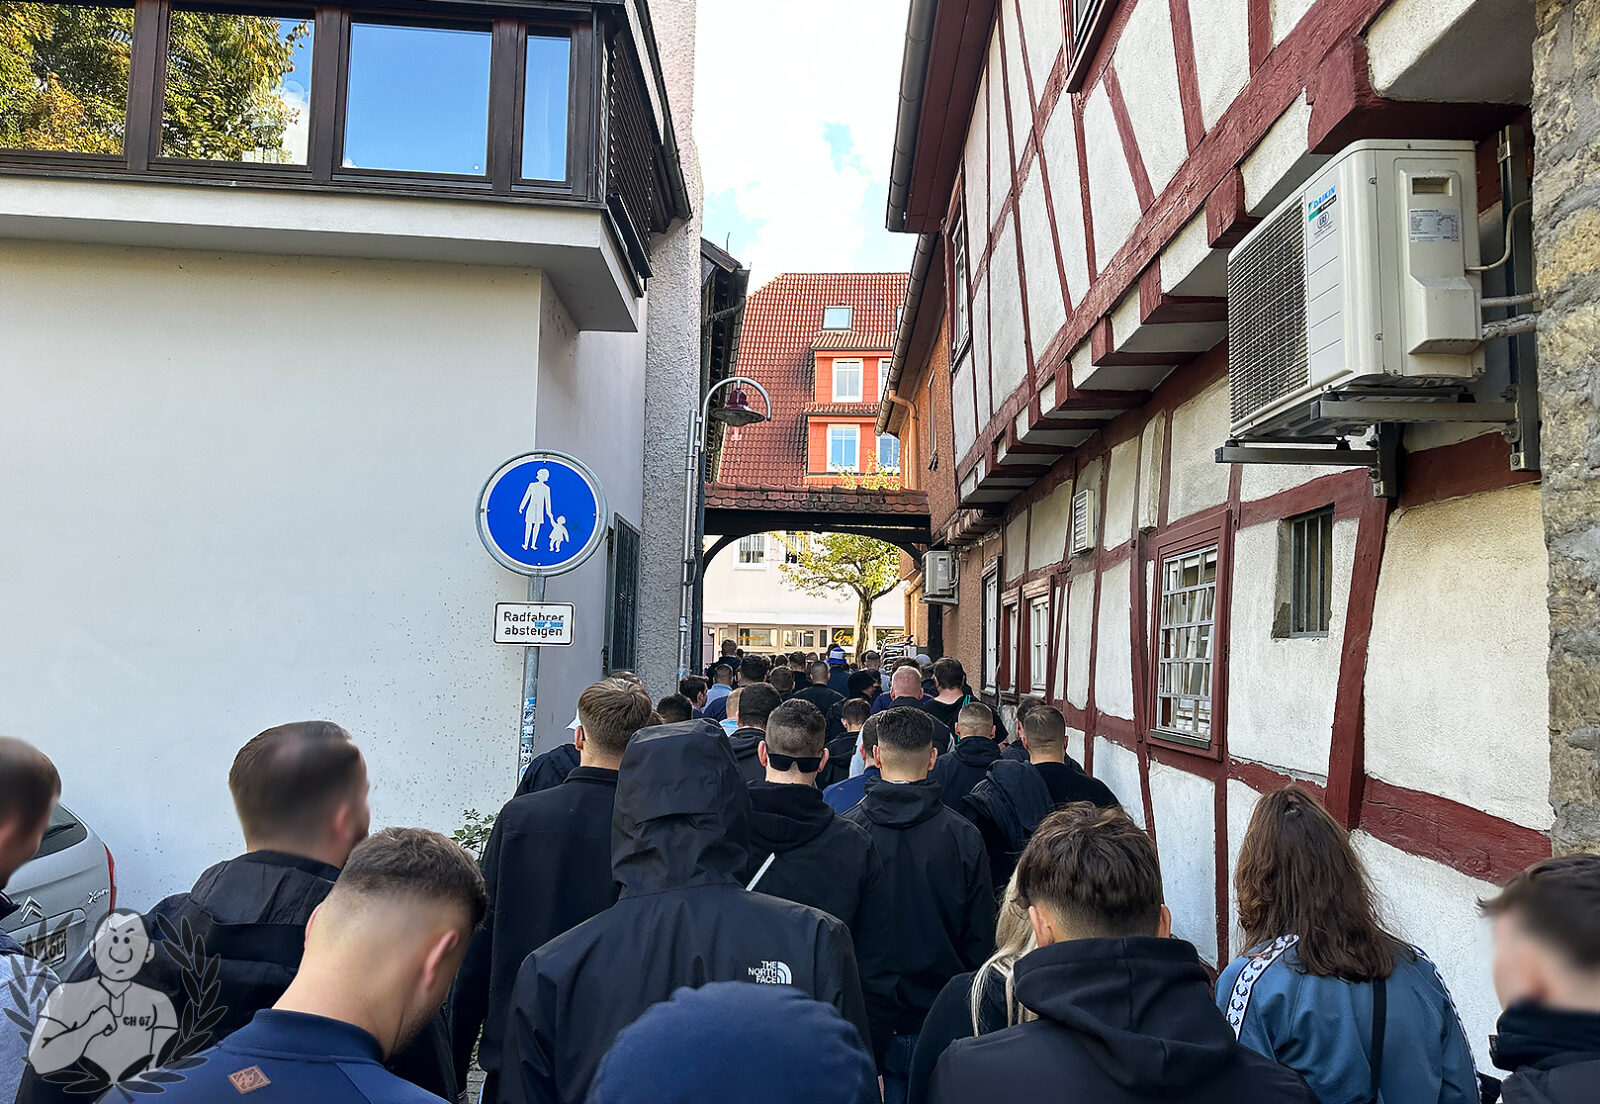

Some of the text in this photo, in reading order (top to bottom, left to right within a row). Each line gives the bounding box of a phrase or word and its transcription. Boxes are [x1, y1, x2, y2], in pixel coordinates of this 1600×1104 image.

[504, 611, 564, 622] Radfahrer
[504, 625, 563, 638] absteigen
[761, 960, 777, 969] THE
[748, 967, 777, 977] NORTH
[756, 975, 777, 984] FACE
